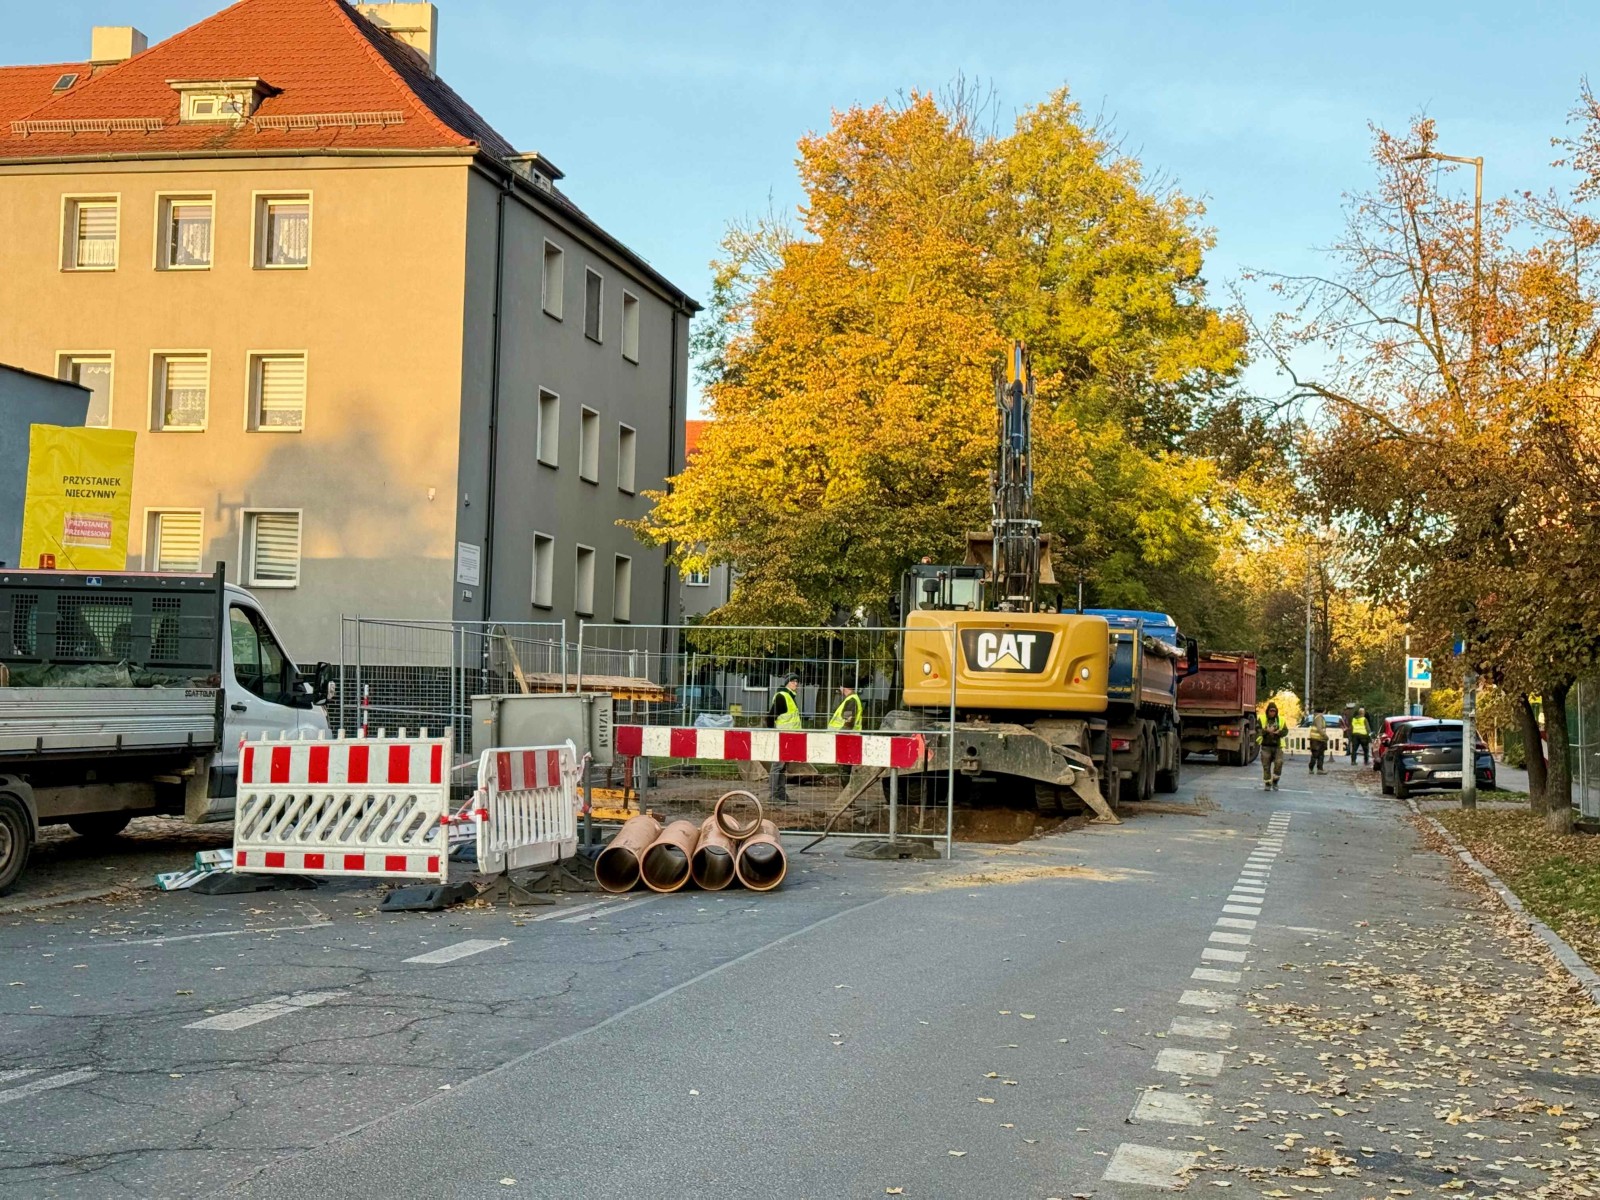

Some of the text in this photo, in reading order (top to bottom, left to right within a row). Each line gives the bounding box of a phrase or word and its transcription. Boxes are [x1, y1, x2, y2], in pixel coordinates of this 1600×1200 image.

[63, 475, 121, 487] PRZYSTANEK
[65, 488, 117, 499] NIECZYNNY
[68, 519, 109, 529] PRZYSTANEK
[977, 632, 1037, 670] CAT
